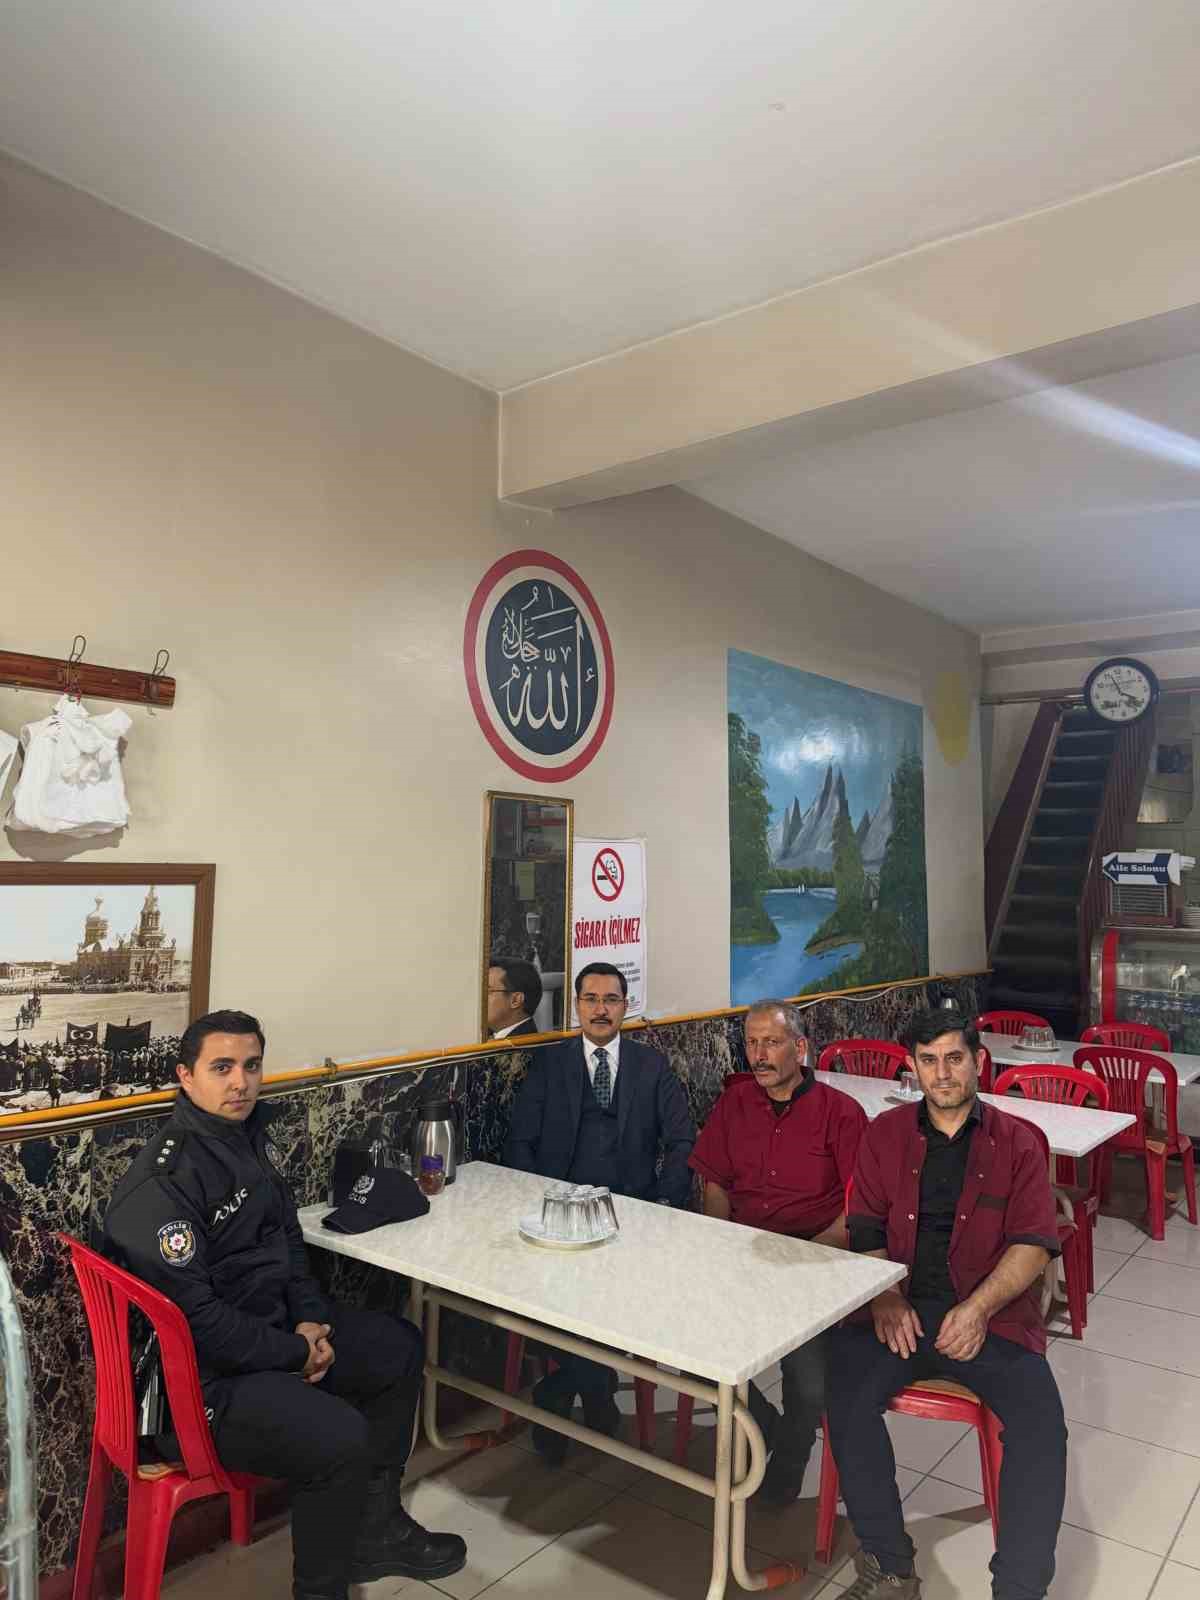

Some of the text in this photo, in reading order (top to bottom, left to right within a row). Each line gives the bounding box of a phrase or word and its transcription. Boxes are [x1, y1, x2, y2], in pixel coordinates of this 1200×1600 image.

[1130, 863, 1166, 873] Salonu
[575, 915, 640, 949] SİGARA İÇİLMEZ
